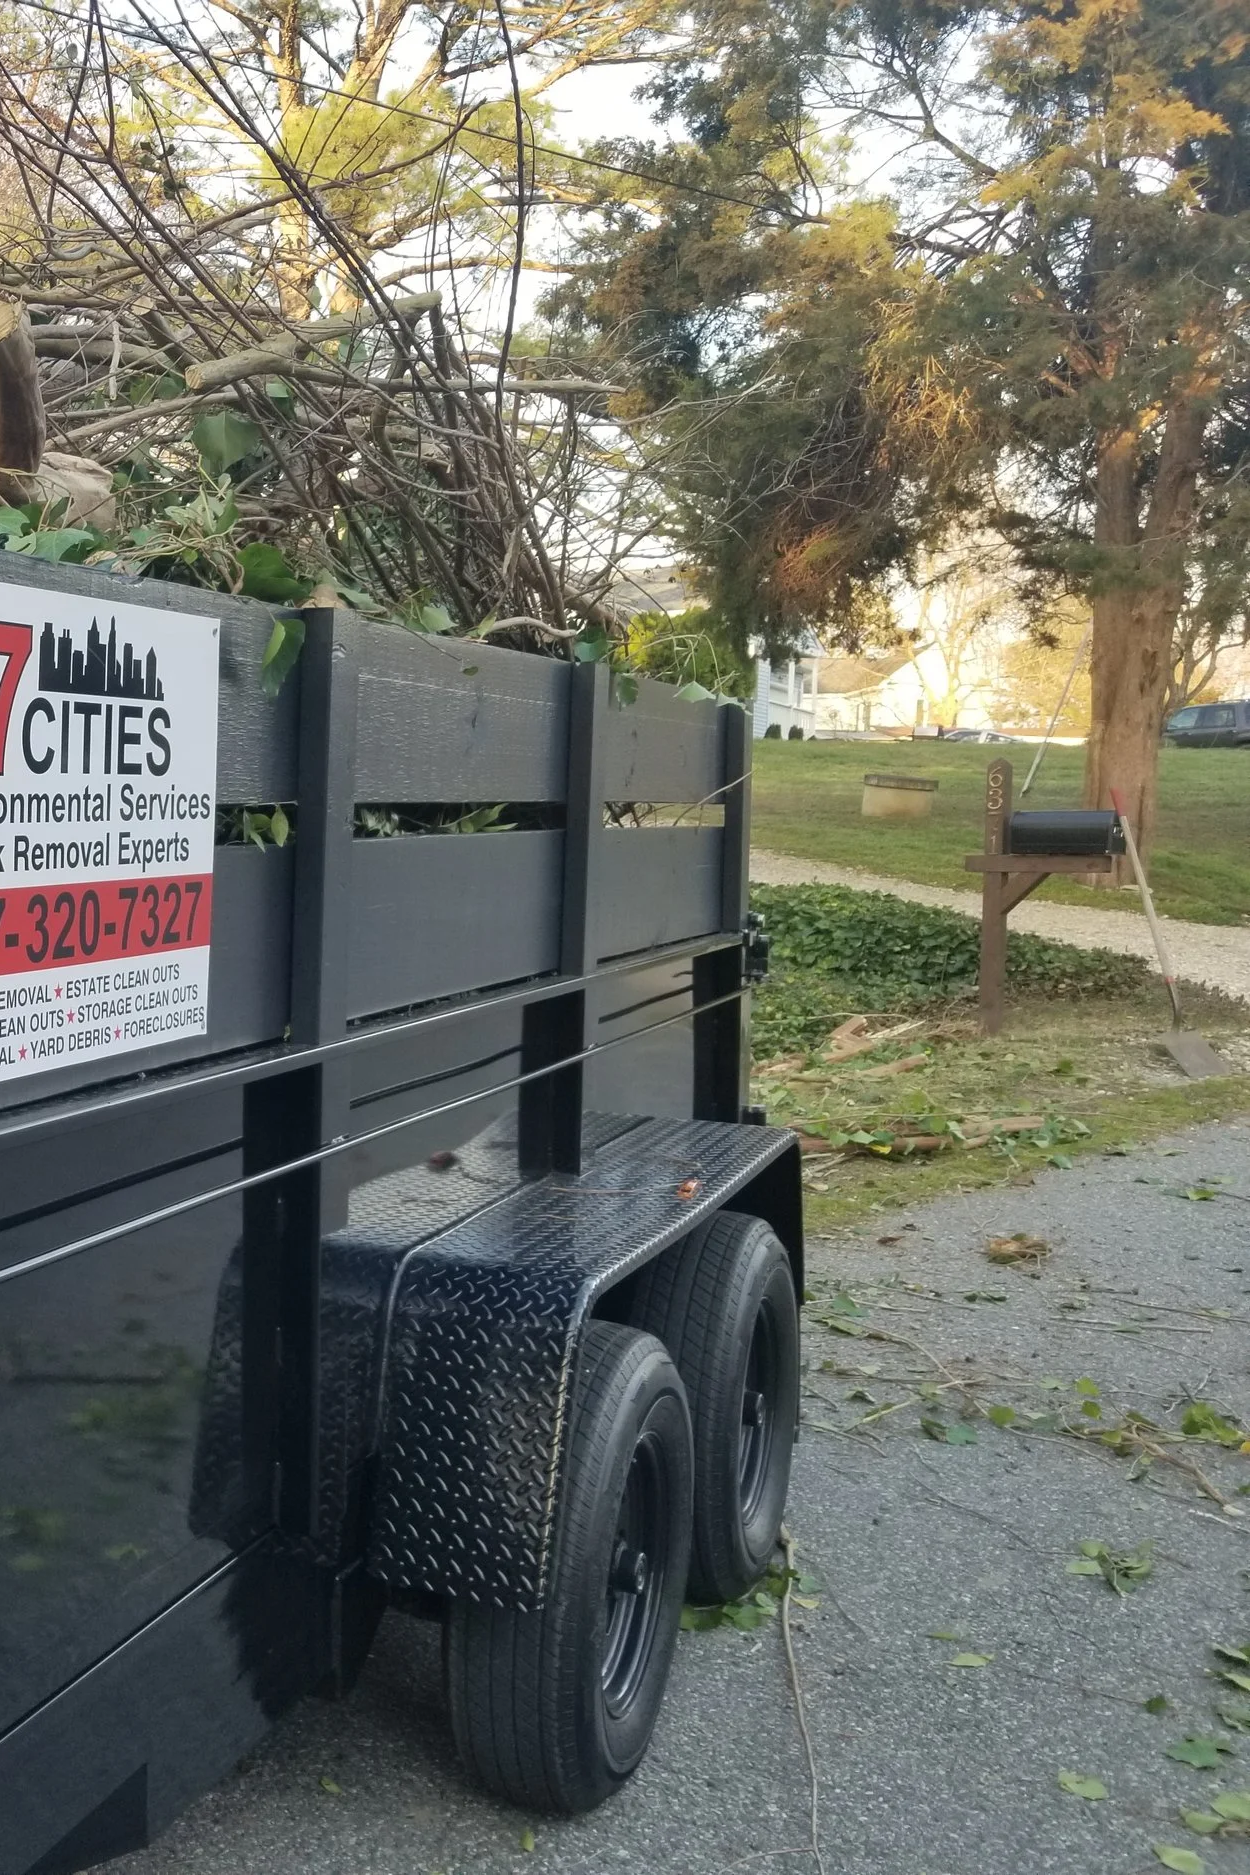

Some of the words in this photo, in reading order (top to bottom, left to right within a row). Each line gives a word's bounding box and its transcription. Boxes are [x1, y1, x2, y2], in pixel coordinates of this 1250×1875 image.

[21, 696, 172, 777] CITIES
[119, 783, 211, 823] Services
[14, 832, 110, 874] Removal
[118, 831, 190, 873] Experts
[65, 975, 111, 1000] ESTATE
[113, 968, 150, 992] CLEAN
[151, 963, 181, 984] OUTS
[29, 1008, 65, 1034] OUTS
[77, 996, 132, 1024] STORAGE
[134, 989, 170, 1013] CLEAN
[171, 983, 199, 1004] OUTS
[123, 1006, 205, 1040] FORECLOSURES
[30, 1035, 65, 1060] YARD
[68, 1026, 112, 1051] DEBRIS
